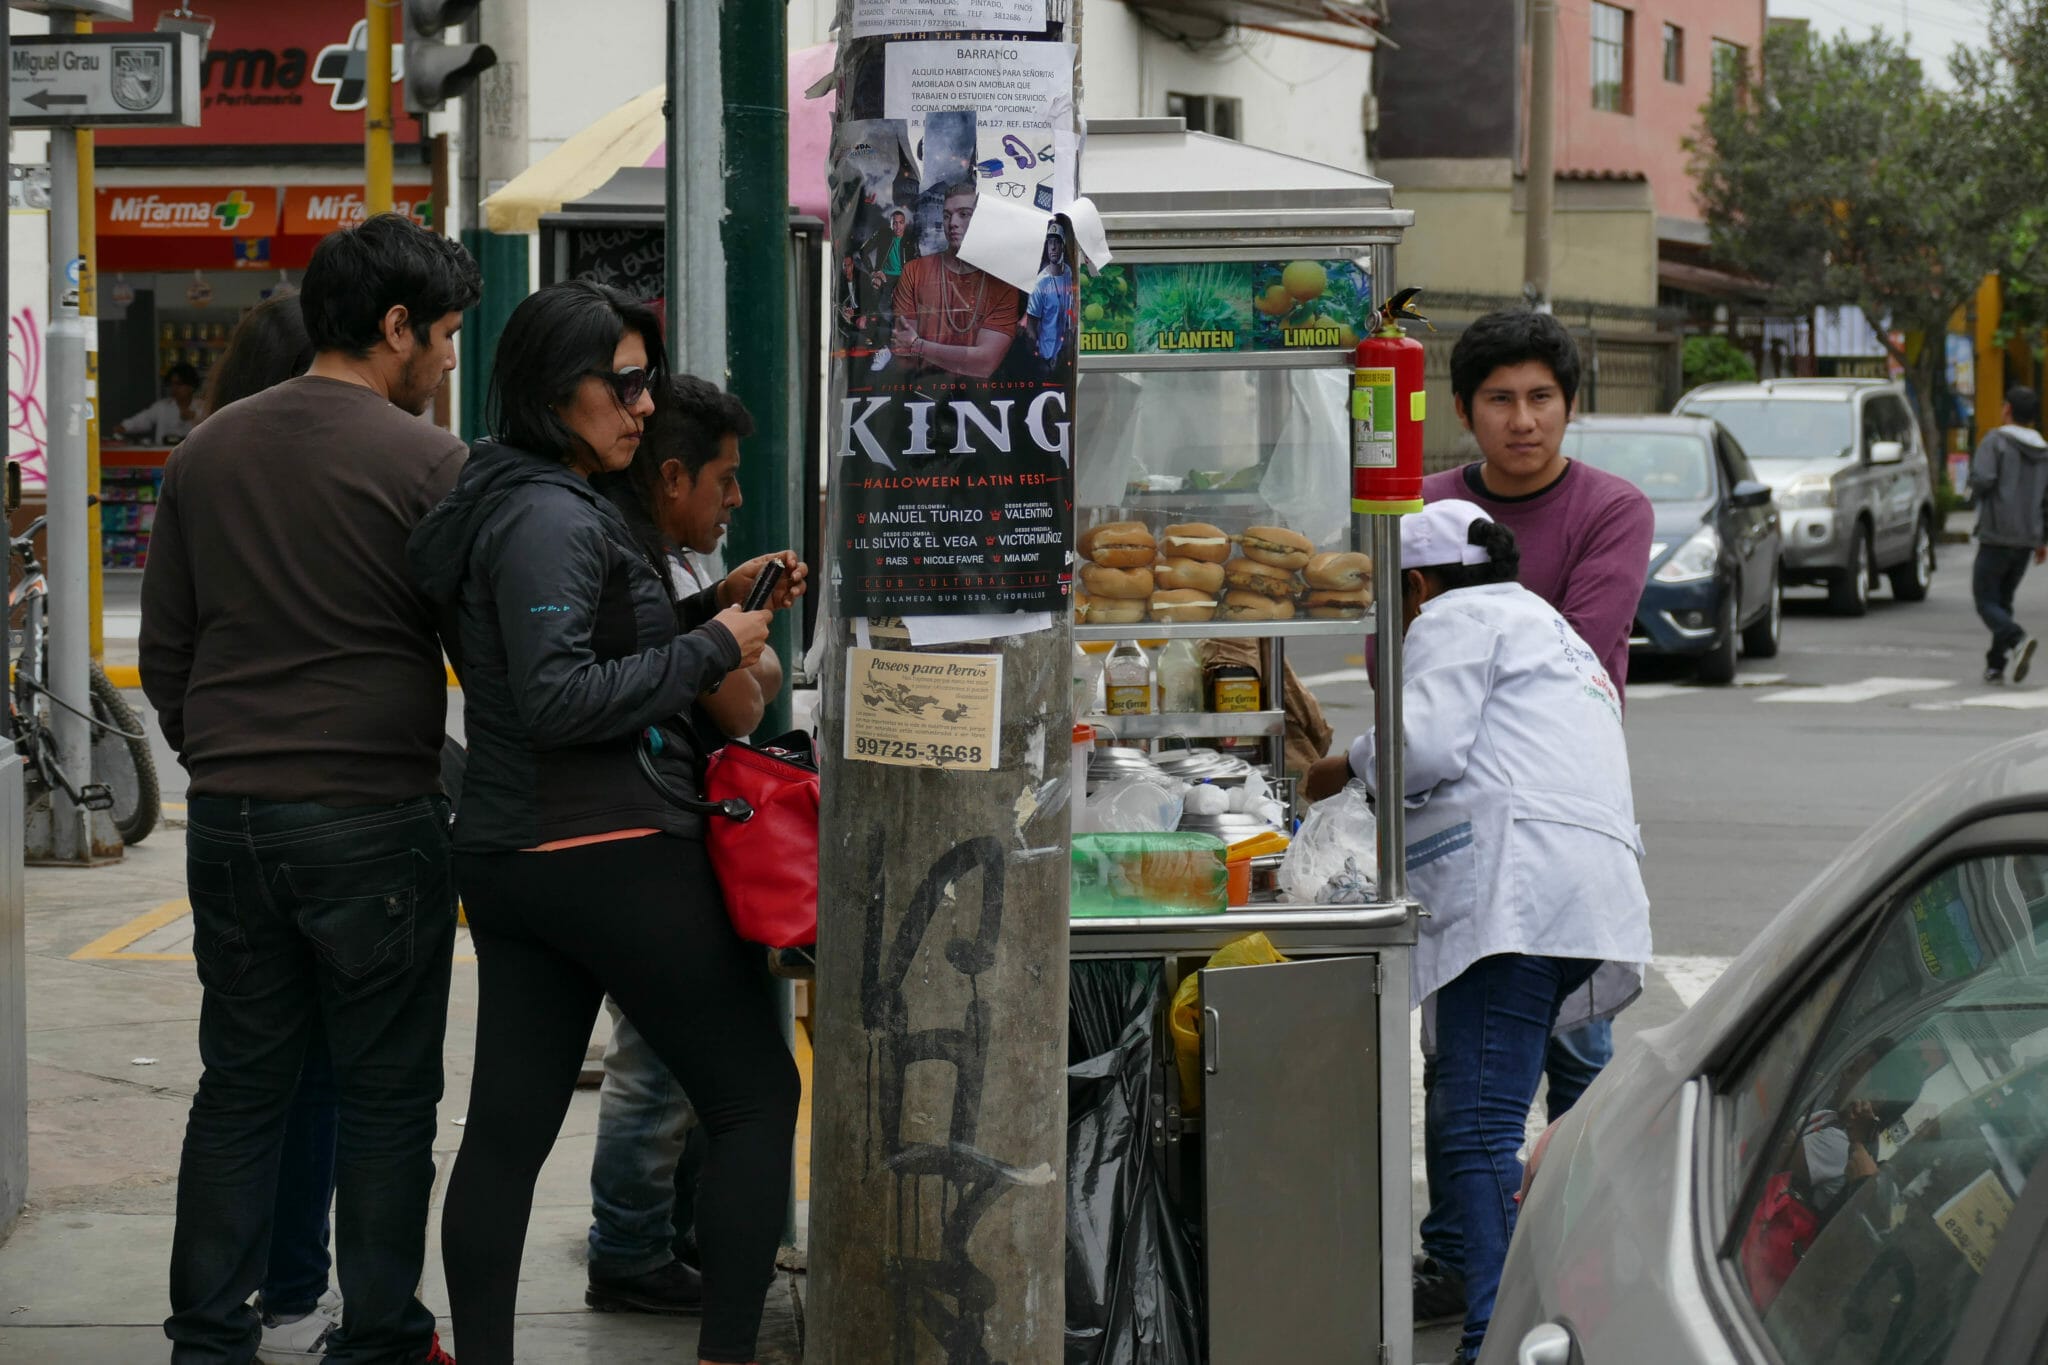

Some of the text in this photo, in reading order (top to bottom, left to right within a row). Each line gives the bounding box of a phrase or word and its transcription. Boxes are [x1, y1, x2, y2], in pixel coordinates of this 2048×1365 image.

[894, 32, 926, 40] WITH
[936, 31, 960, 40] THE
[971, 31, 1003, 40] BEST
[956, 48, 1018, 60] BARRANCO
[12, 51, 100, 76] Miguel Grau
[911, 68, 944, 76] ALQUILO
[945, 68, 1001, 77] HABITACIONES
[1002, 69, 1021, 77] PARA
[911, 80, 955, 88] AMOBLADA
[978, 81, 1015, 89] AMOBLAR
[911, 92, 949, 100] TRABAJEN
[958, 92, 996, 100] ESTUDIEN
[997, 93, 1013, 101] CON
[911, 104, 940, 112] COCINA
[110, 194, 211, 222] Mifarma
[306, 194, 411, 221] Mifaa
[1158, 330, 1234, 349] LLANTEN
[1283, 327, 1340, 347] LIMON
[882, 381, 1035, 392] FIESTA TODO INCLUIDO
[836, 390, 1072, 472] KING
[863, 473, 1047, 490] HALLOWEEN LATIN FEST
[869, 507, 1053, 524] MANUEL TURIZO VALENTINO
[854, 531, 1062, 549] LIL SILVIO & EL VEGA VICTOR MUÑOZ
[885, 552, 1040, 566] RAES NICOLE FAVRE MIA MONT
[865, 578, 905, 588] CLUB
[918, 576, 1006, 587] CULTURAL
[885, 595, 933, 603] ALAMEDA
[871, 657, 989, 678] Paseos para Perros
[856, 736, 982, 764] 99725-3668
